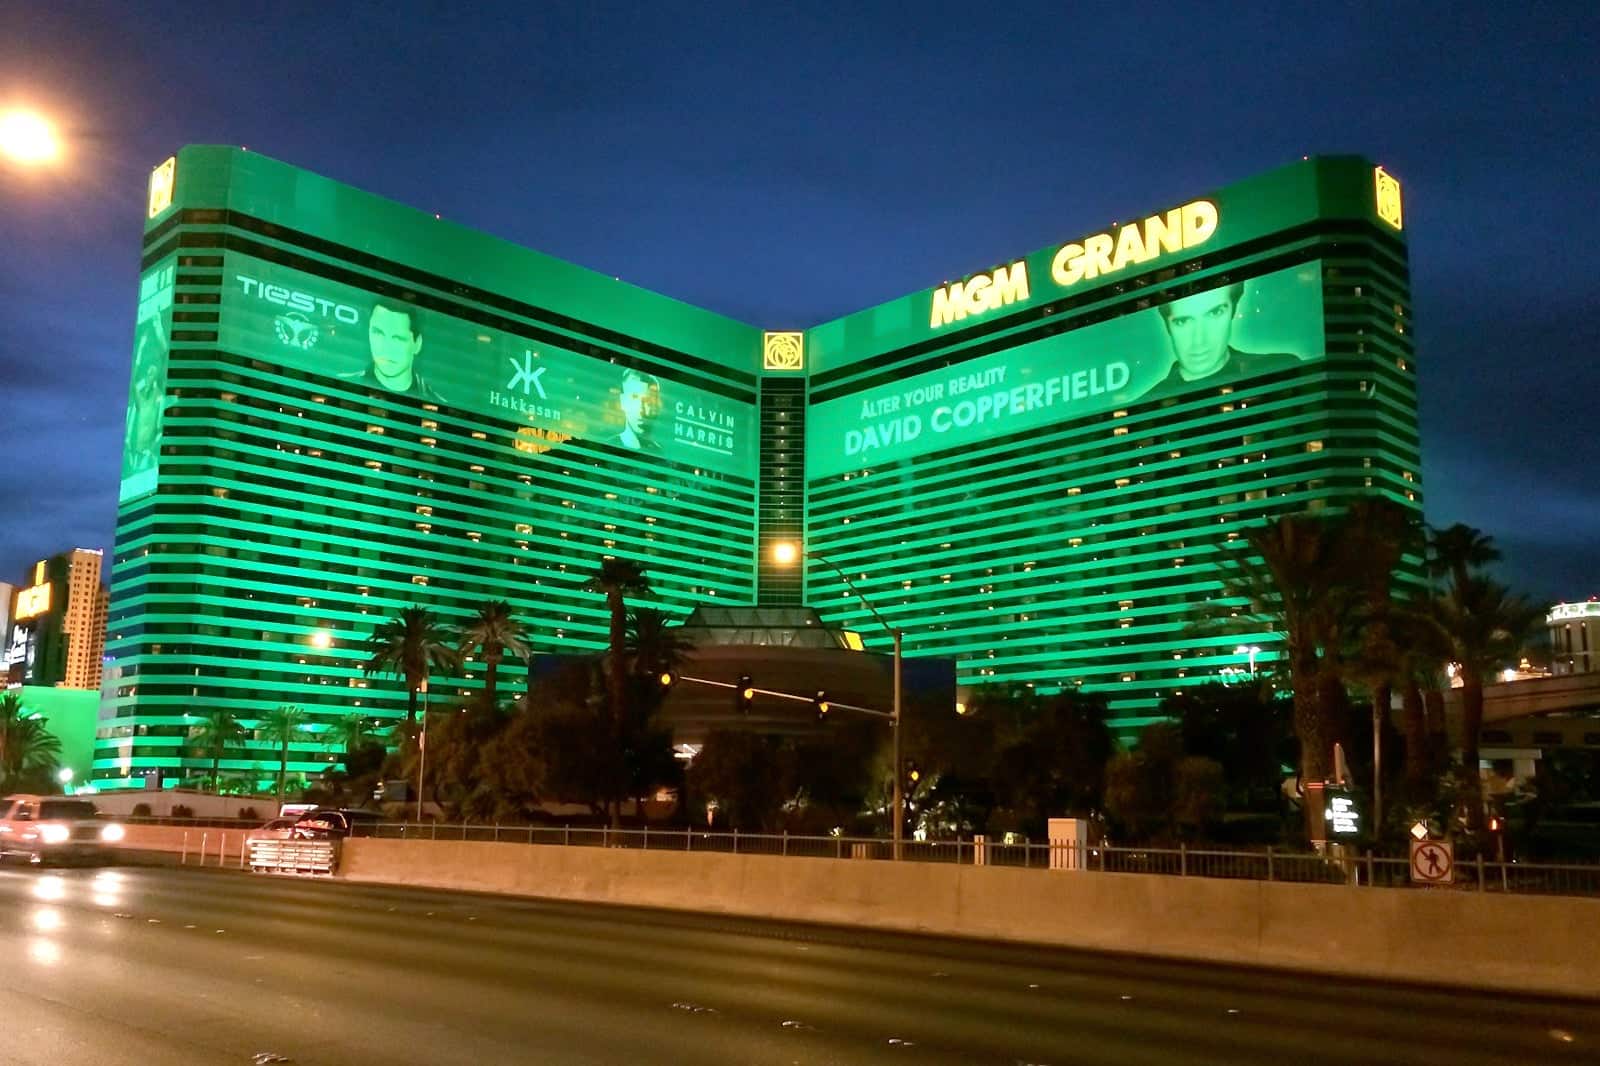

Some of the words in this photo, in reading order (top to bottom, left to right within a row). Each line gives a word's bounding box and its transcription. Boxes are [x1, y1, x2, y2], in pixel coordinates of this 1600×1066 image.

[930, 260, 1030, 329] MGM
[1051, 200, 1218, 286] GRAND
[490, 391, 561, 421] Hakkasan
[844, 415, 922, 456] DAVID
[931, 362, 1130, 433] COPPERFIELD
[860, 394, 900, 420] ALTER
[904, 383, 944, 408] YOUR
[949, 365, 1007, 397] REALITY
[674, 422, 734, 449] HARRIS
[675, 401, 735, 428] CALVIN
